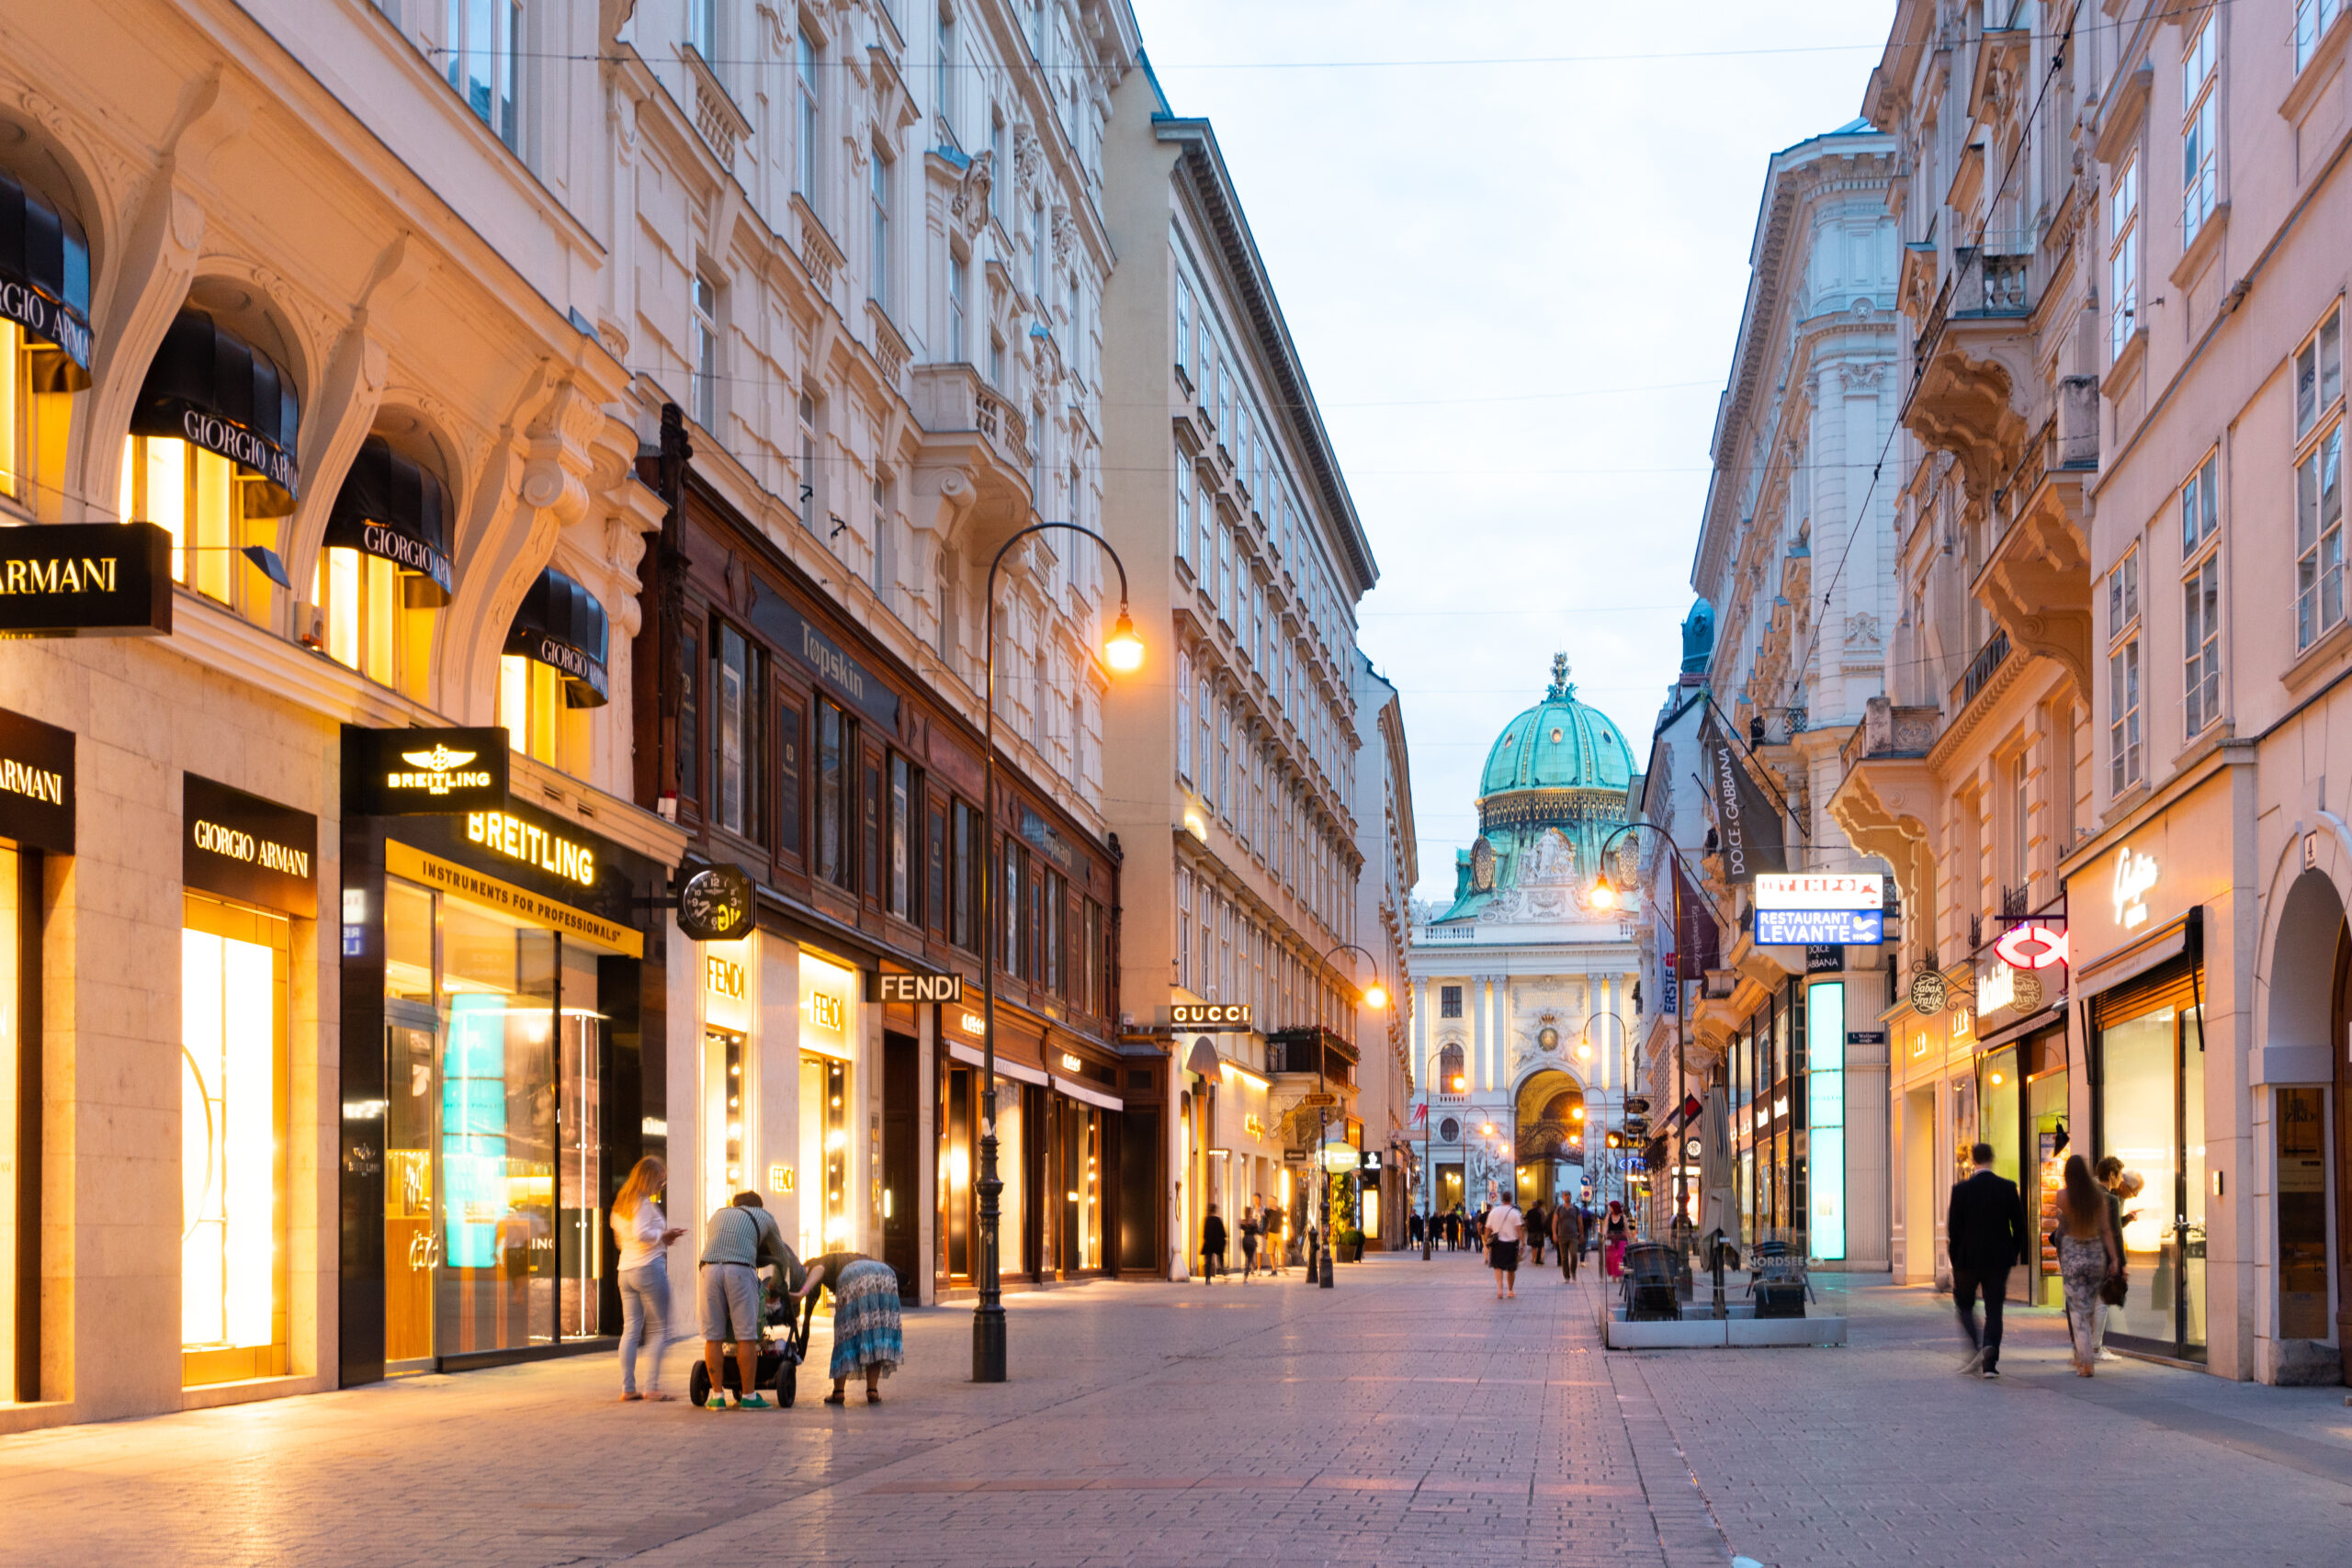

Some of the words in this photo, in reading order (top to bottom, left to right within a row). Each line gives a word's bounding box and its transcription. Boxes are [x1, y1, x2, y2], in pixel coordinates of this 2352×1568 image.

[51, 309, 93, 367] ARMA
[184, 410, 266, 469] GIORGIO
[364, 526, 432, 571] GIORGIO
[541, 639, 587, 677] GIORGIO
[801, 620, 863, 700] Topskin
[388, 773, 491, 787] BREITLING
[1718, 748, 1739, 819] GABBANA
[195, 819, 254, 863] GIORGIO
[257, 840, 308, 878] ARMANI
[469, 812, 593, 885] BREITLING
[1728, 829, 1745, 874] DOLCE
[2307, 838, 2313, 857] 4
[423, 861, 508, 903] INSTRUMENTS
[513, 895, 533, 913] FOR
[730, 897, 737, 907] 3
[1760, 912, 1849, 925] RESTAURANT
[1760, 925, 1850, 942] LEVANTE
[1808, 944, 1829, 954] DOLCE
[707, 955, 744, 999] FENDI
[880, 976, 959, 1000] FENDI
[1664, 969, 1677, 1014] ERSTE
[1913, 978, 1943, 994] Tabak
[814, 992, 842, 1030] FENDI
[1174, 1006, 1248, 1021] GUCCI
[1913, 993, 1943, 1007] Trafik
[773, 1168, 795, 1190] FENDI
[1750, 1256, 1804, 1268] NORDSEE
